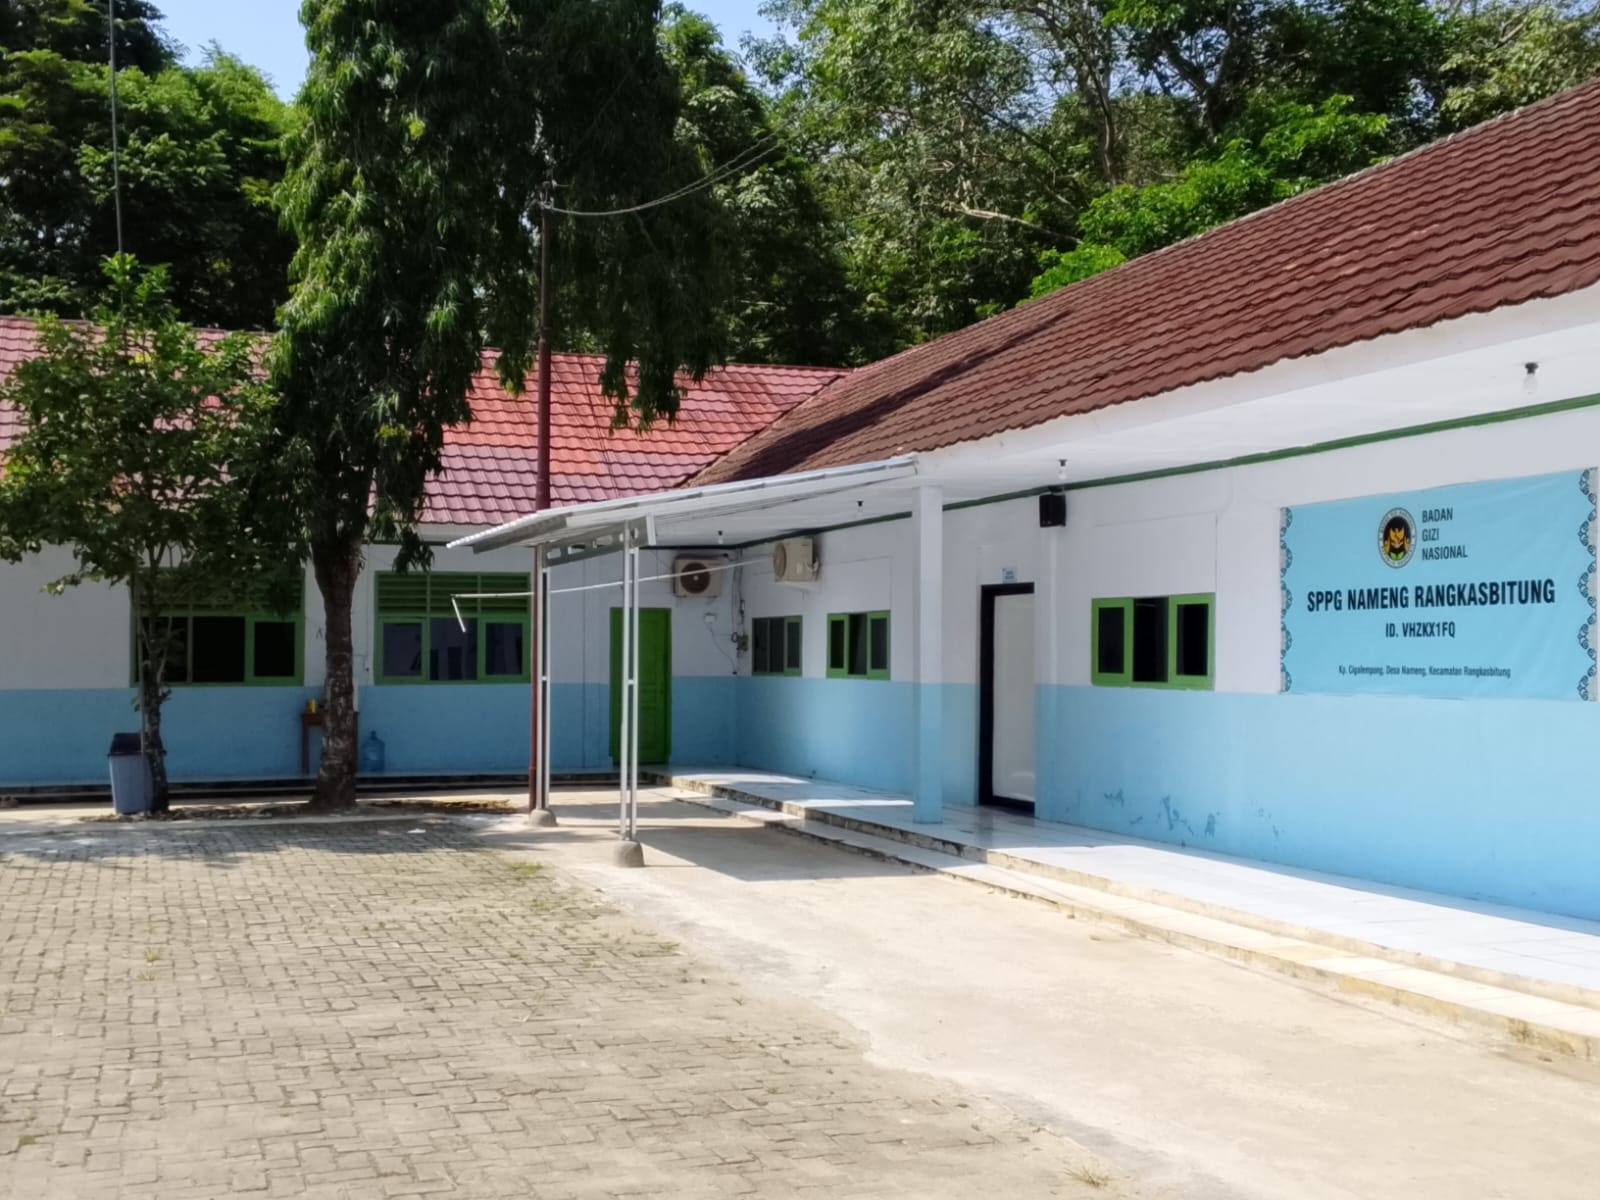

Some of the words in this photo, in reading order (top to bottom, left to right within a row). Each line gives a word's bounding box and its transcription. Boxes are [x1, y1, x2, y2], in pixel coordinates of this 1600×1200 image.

[1422, 507, 1453, 523] BADAN
[1422, 528, 1439, 542] GIZI
[1422, 545, 1468, 561] NASIONAL
[1307, 590, 1342, 612] SPPG
[1347, 587, 1409, 611] NAMENG
[1415, 578, 1555, 608] RANGKASBITUNG
[1385, 622, 1399, 638] ID.
[1402, 621, 1455, 638] VHZKX1FQ
[1339, 665, 1347, 676] Kp.
[1386, 665, 1400, 675] Desa
[1401, 665, 1427, 678] Nameng,
[1429, 665, 1462, 676] Kecamatan
[1463, 666, 1511, 679] Rangkasbitung
